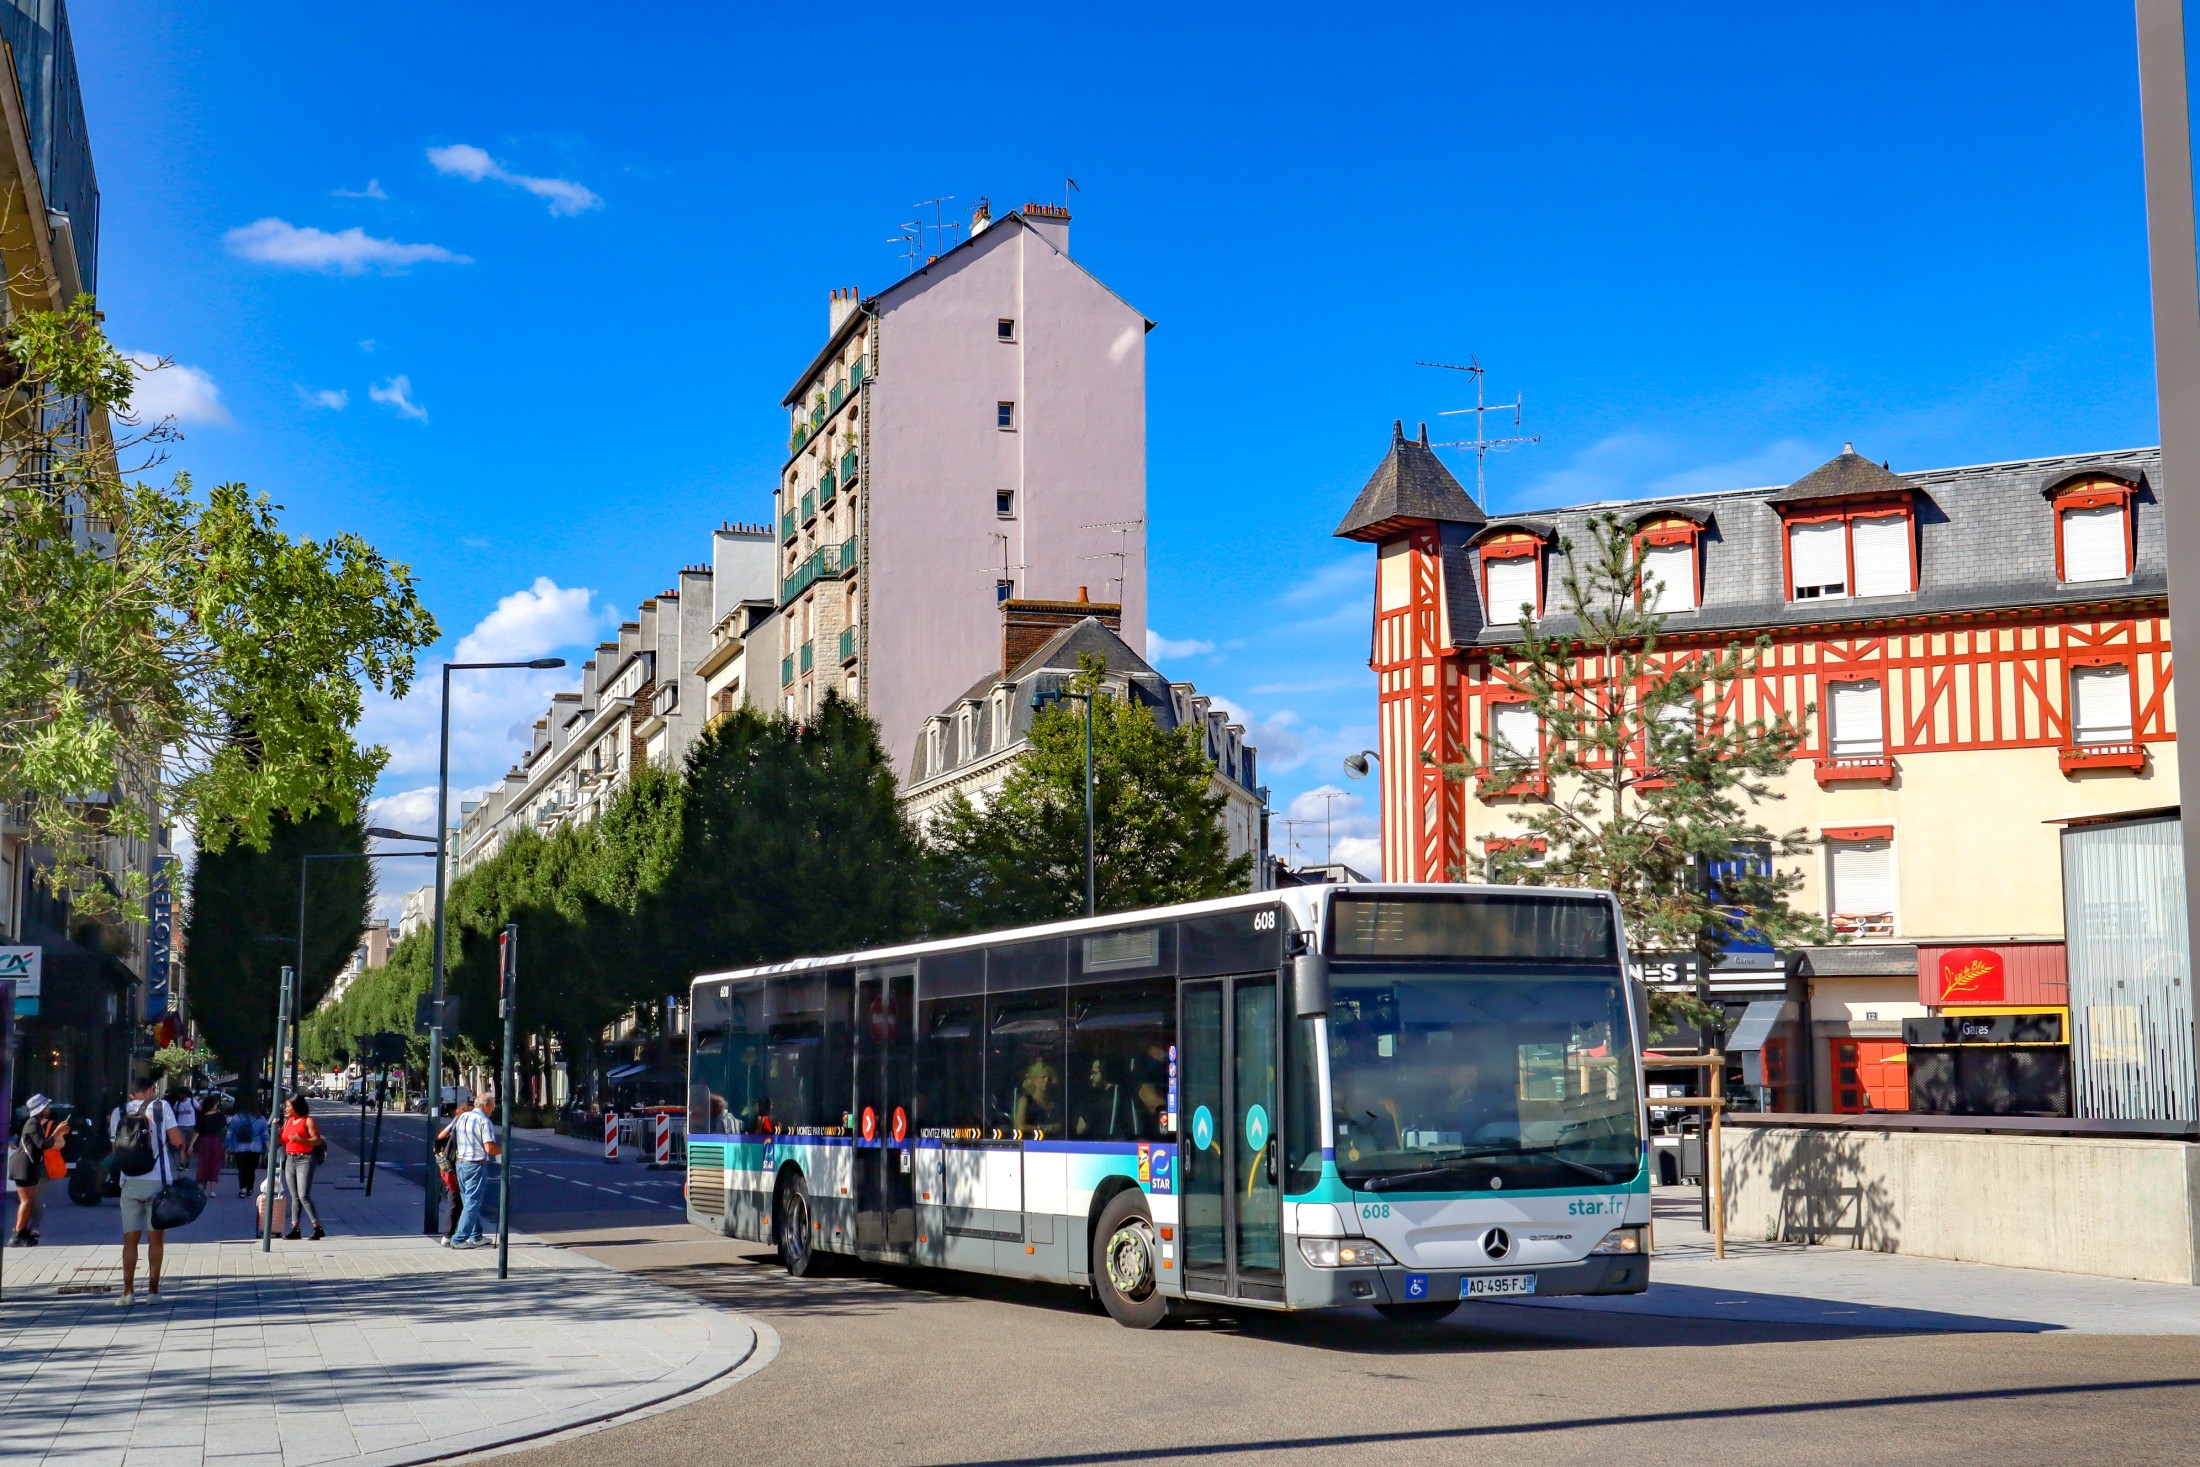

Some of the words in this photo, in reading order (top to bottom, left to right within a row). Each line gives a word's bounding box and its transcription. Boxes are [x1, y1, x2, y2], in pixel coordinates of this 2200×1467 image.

[1254, 910, 1275, 931] 608
[153, 878, 171, 991] NOVOTE
[719, 985, 730, 998] 608
[1866, 1012, 1877, 1020] 12
[1962, 1021, 1989, 1036] Gares
[812, 1126, 820, 1136] PAR
[920, 1127, 940, 1138] MONTEZ
[940, 1127, 950, 1138] PAR
[1152, 1178, 1170, 1189] STAR
[1362, 1204, 1390, 1219] 608
[1568, 1195, 1623, 1216] star.fr
